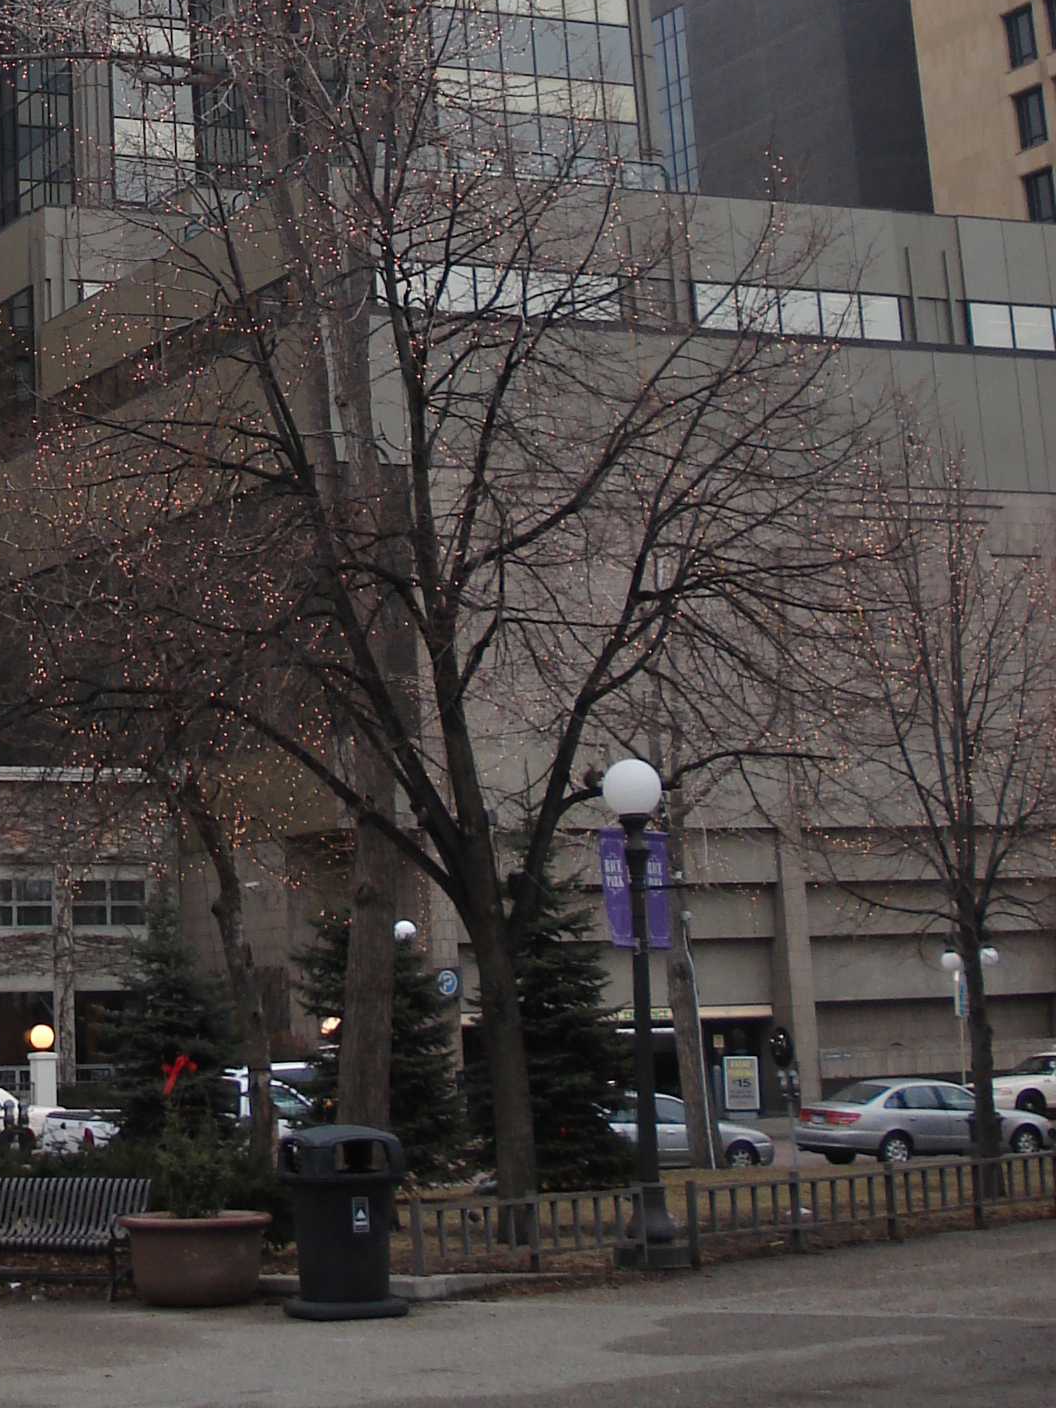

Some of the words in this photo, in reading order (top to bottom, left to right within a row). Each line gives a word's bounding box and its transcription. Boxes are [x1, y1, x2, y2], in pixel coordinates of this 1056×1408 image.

[604, 859, 623, 873] RICE
[647, 861, 663, 876] RICE
[606, 875, 624, 888] PARK
[648, 877, 663, 887] PARK
